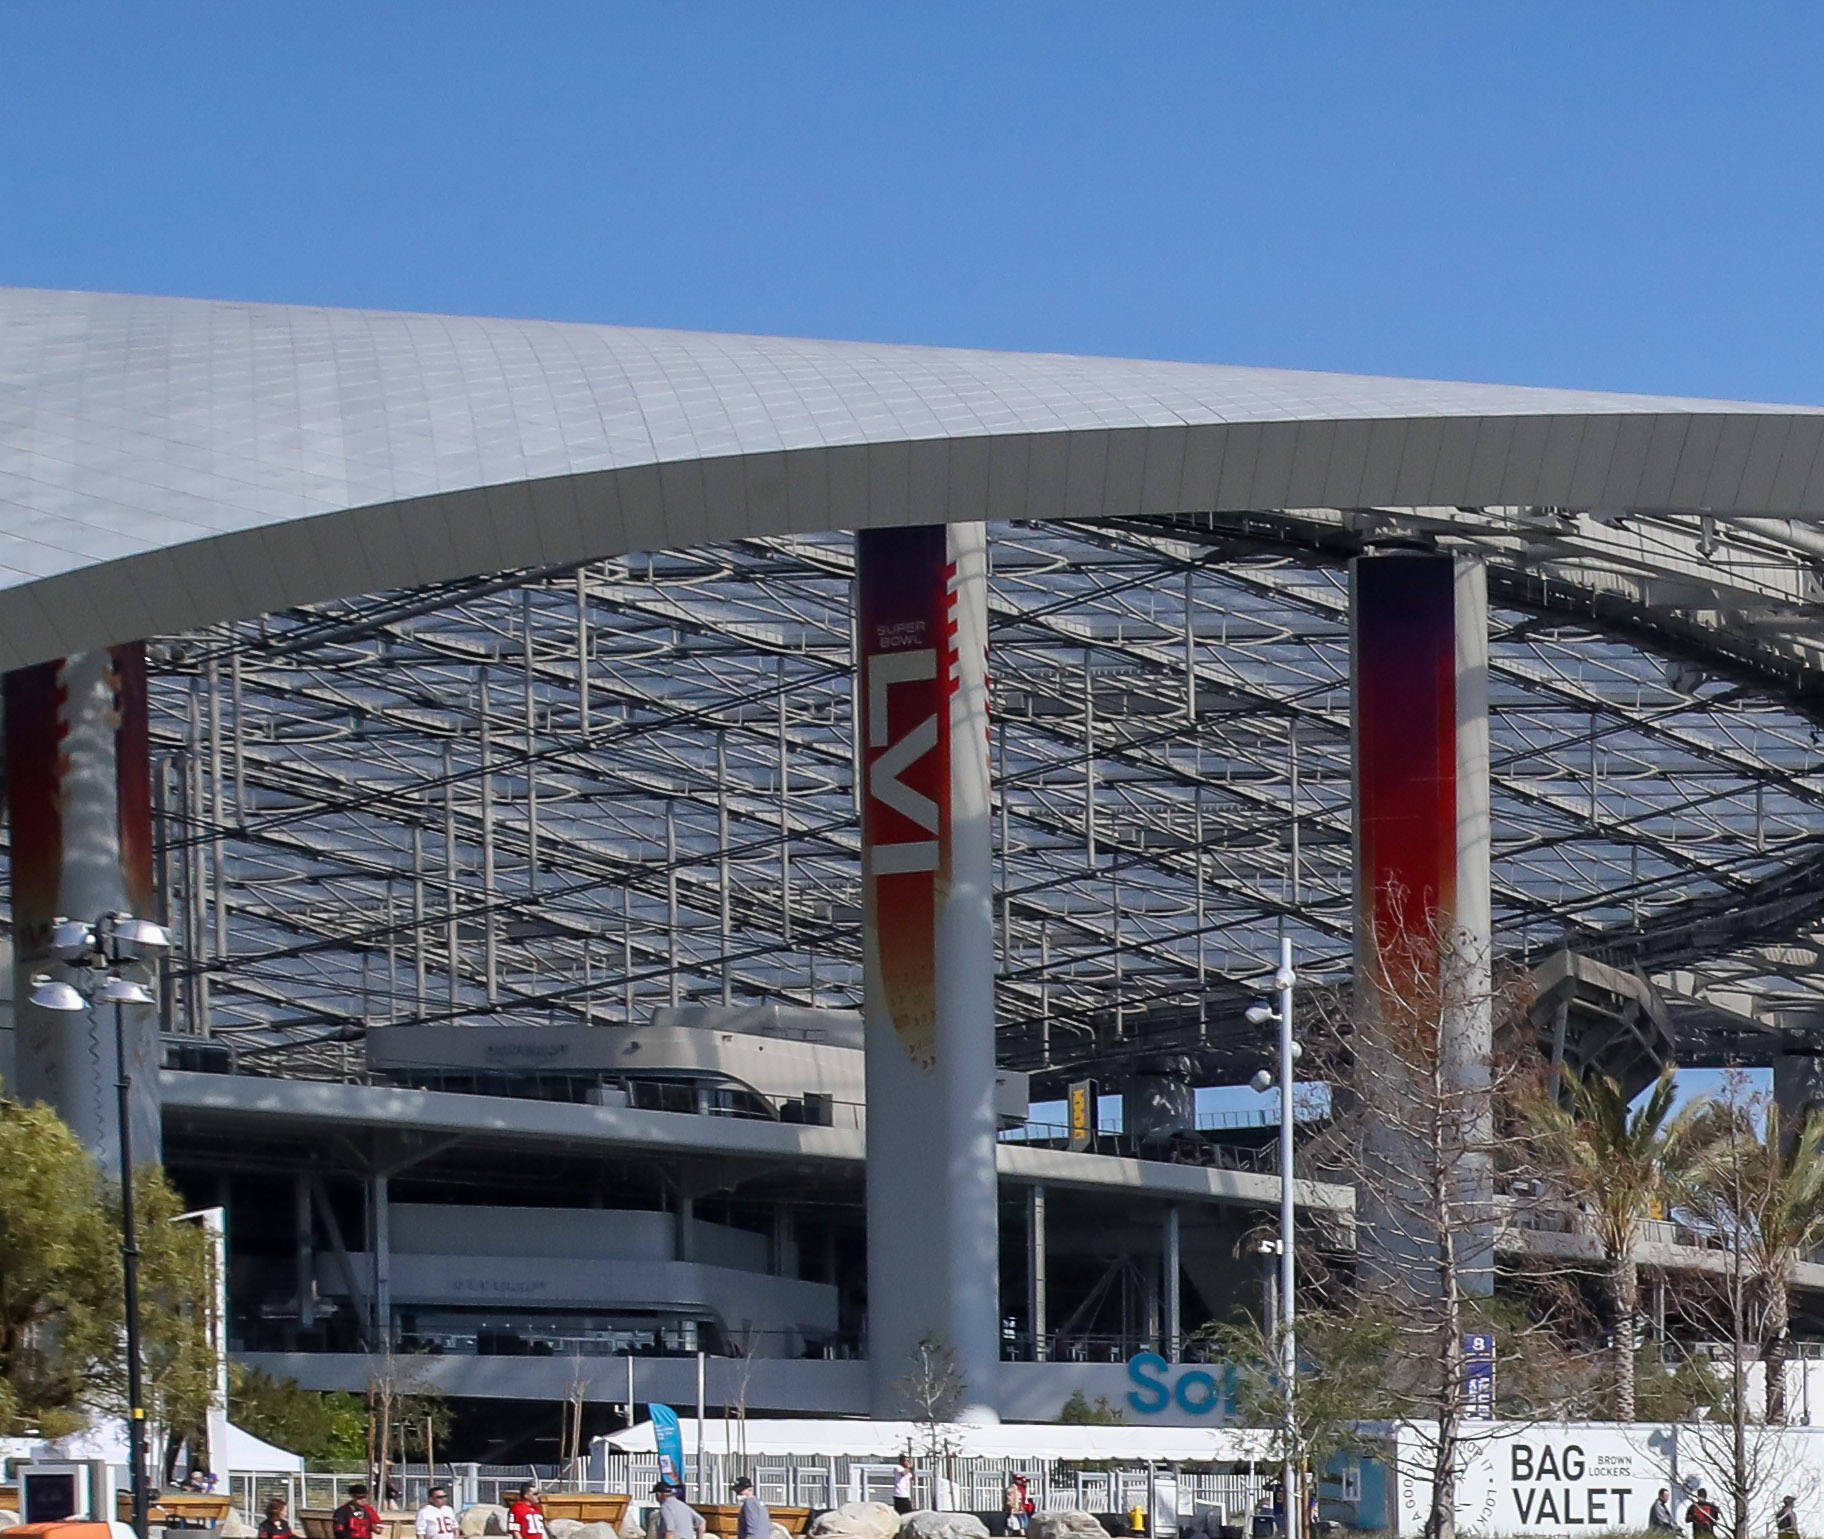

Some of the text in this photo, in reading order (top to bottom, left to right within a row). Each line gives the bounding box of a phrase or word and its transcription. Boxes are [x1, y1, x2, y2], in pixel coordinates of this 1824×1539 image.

[877, 620, 926, 636] SUPER
[880, 636, 922, 648] BOWL
[868, 648, 940, 875] LVI
[1512, 1444, 1585, 1481] BAG
[1598, 1455, 1632, 1465] BROWN
[1589, 1467, 1631, 1477] LOCKERS
[1513, 1488, 1632, 1524] VALET
